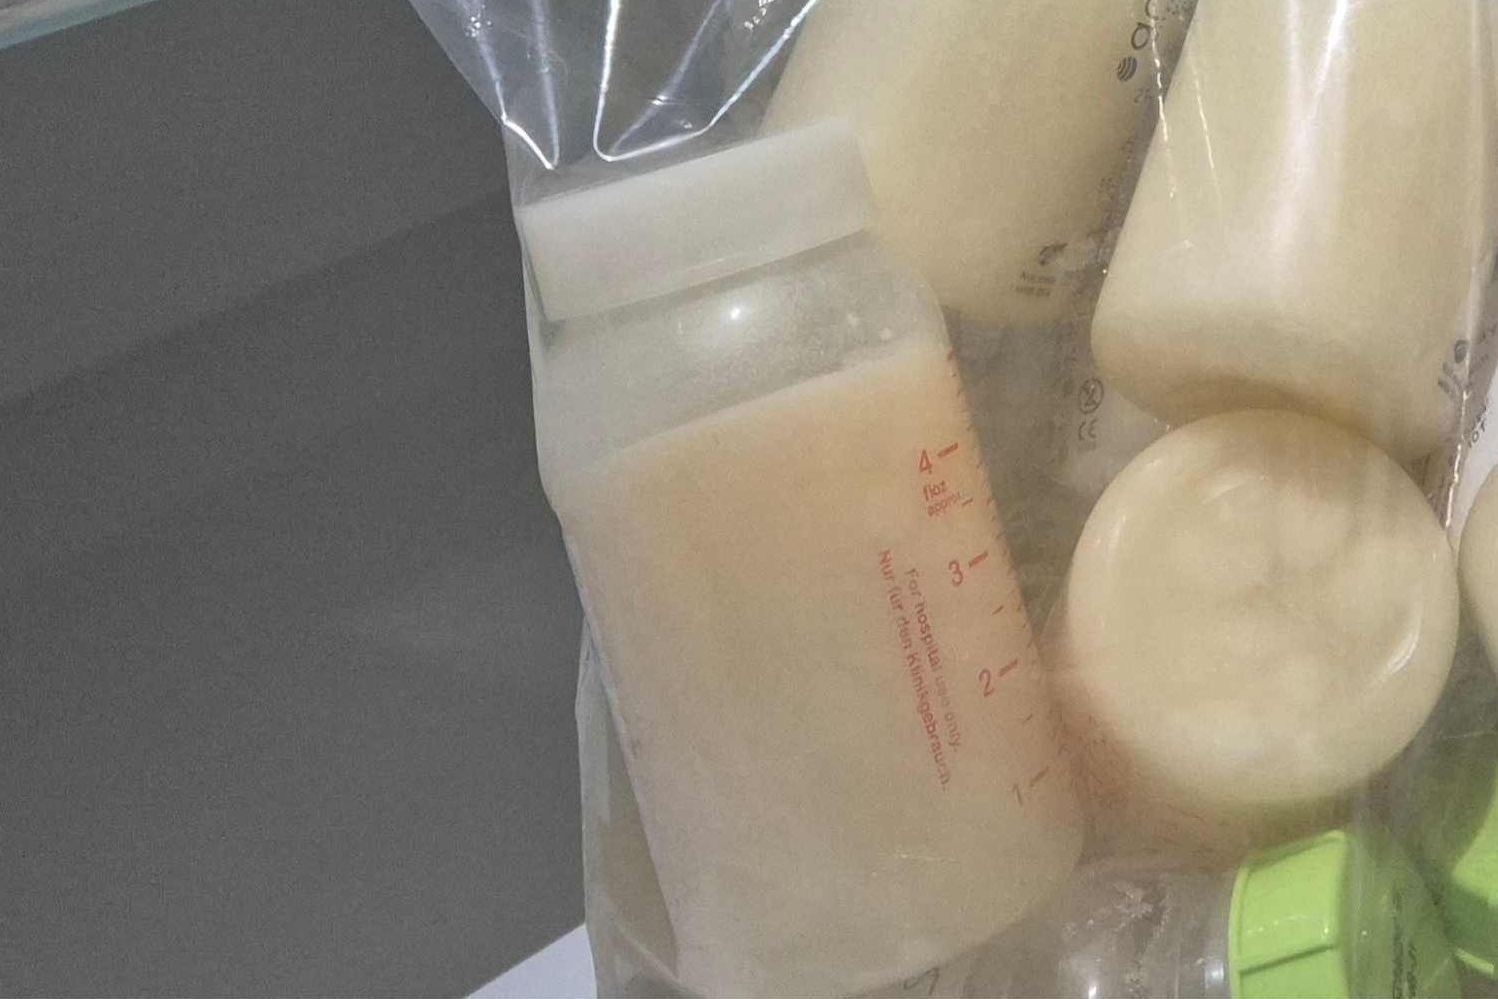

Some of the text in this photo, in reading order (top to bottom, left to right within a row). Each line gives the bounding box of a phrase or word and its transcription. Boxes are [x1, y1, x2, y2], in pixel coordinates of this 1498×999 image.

[918, 449, 933, 475] 4
[948, 559, 964, 587] 3
[879, 549, 896, 581] Nur
[895, 615, 912, 650] den
[904, 568, 922, 598] For
[914, 600, 944, 675] hospital
[978, 668, 996, 698] 2
[1011, 783, 1024, 808] 1
